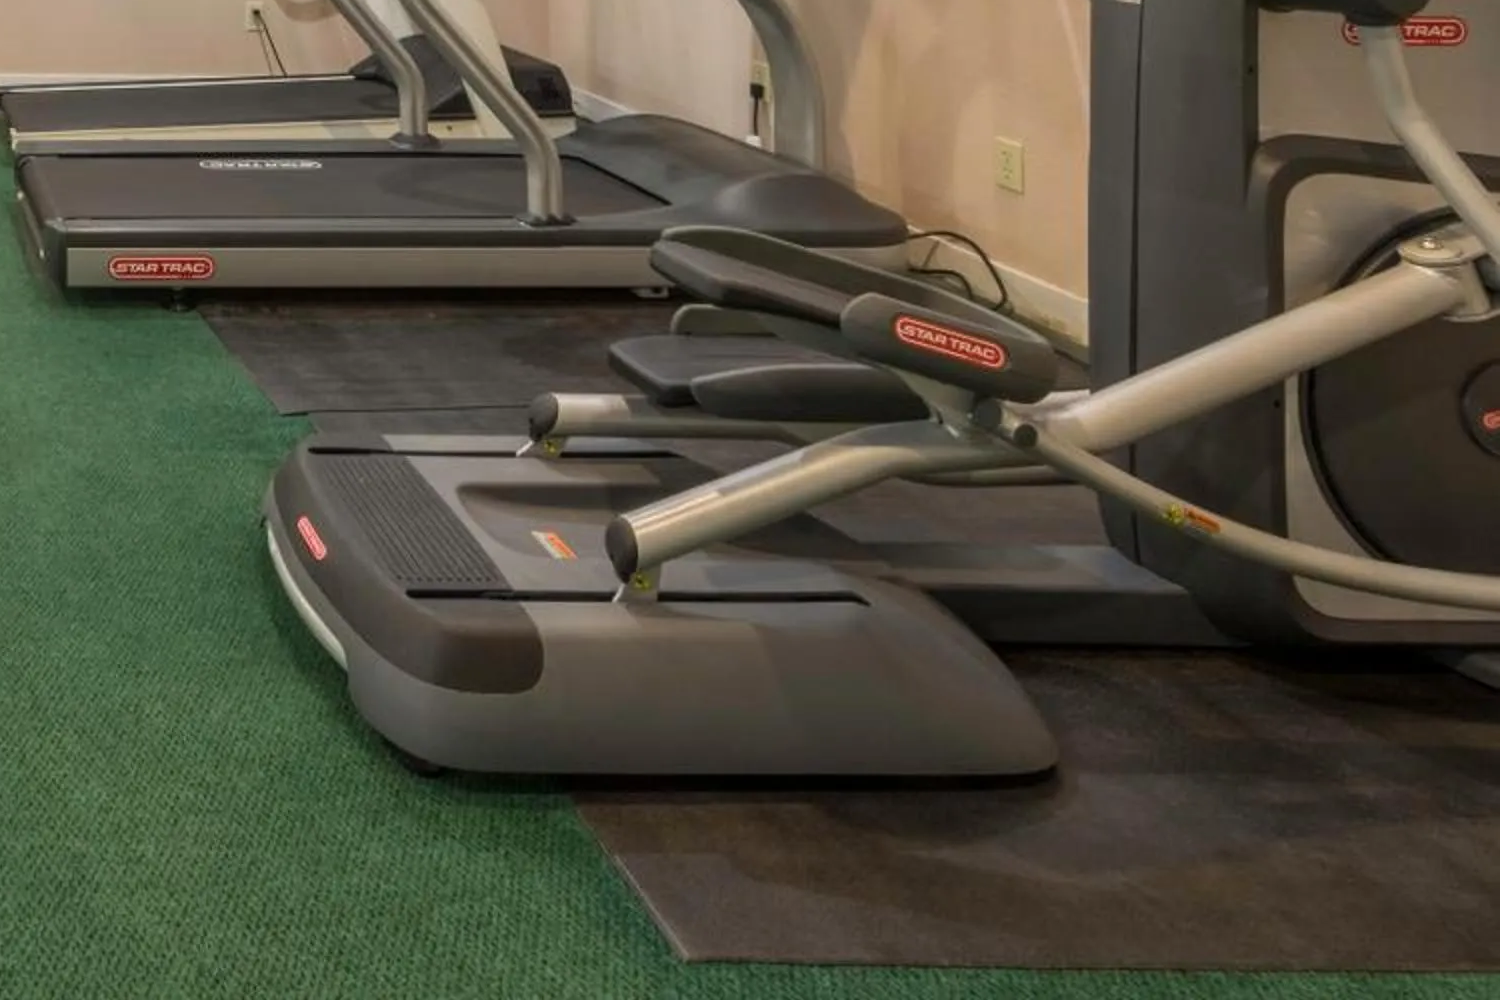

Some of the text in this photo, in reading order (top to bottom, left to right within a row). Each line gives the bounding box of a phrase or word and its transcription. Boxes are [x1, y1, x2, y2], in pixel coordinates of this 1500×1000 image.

[1403, 25, 1457, 37] TRAC
[115, 263, 206, 273] STAR TRAC
[901, 325, 999, 360] STAR TRAC
